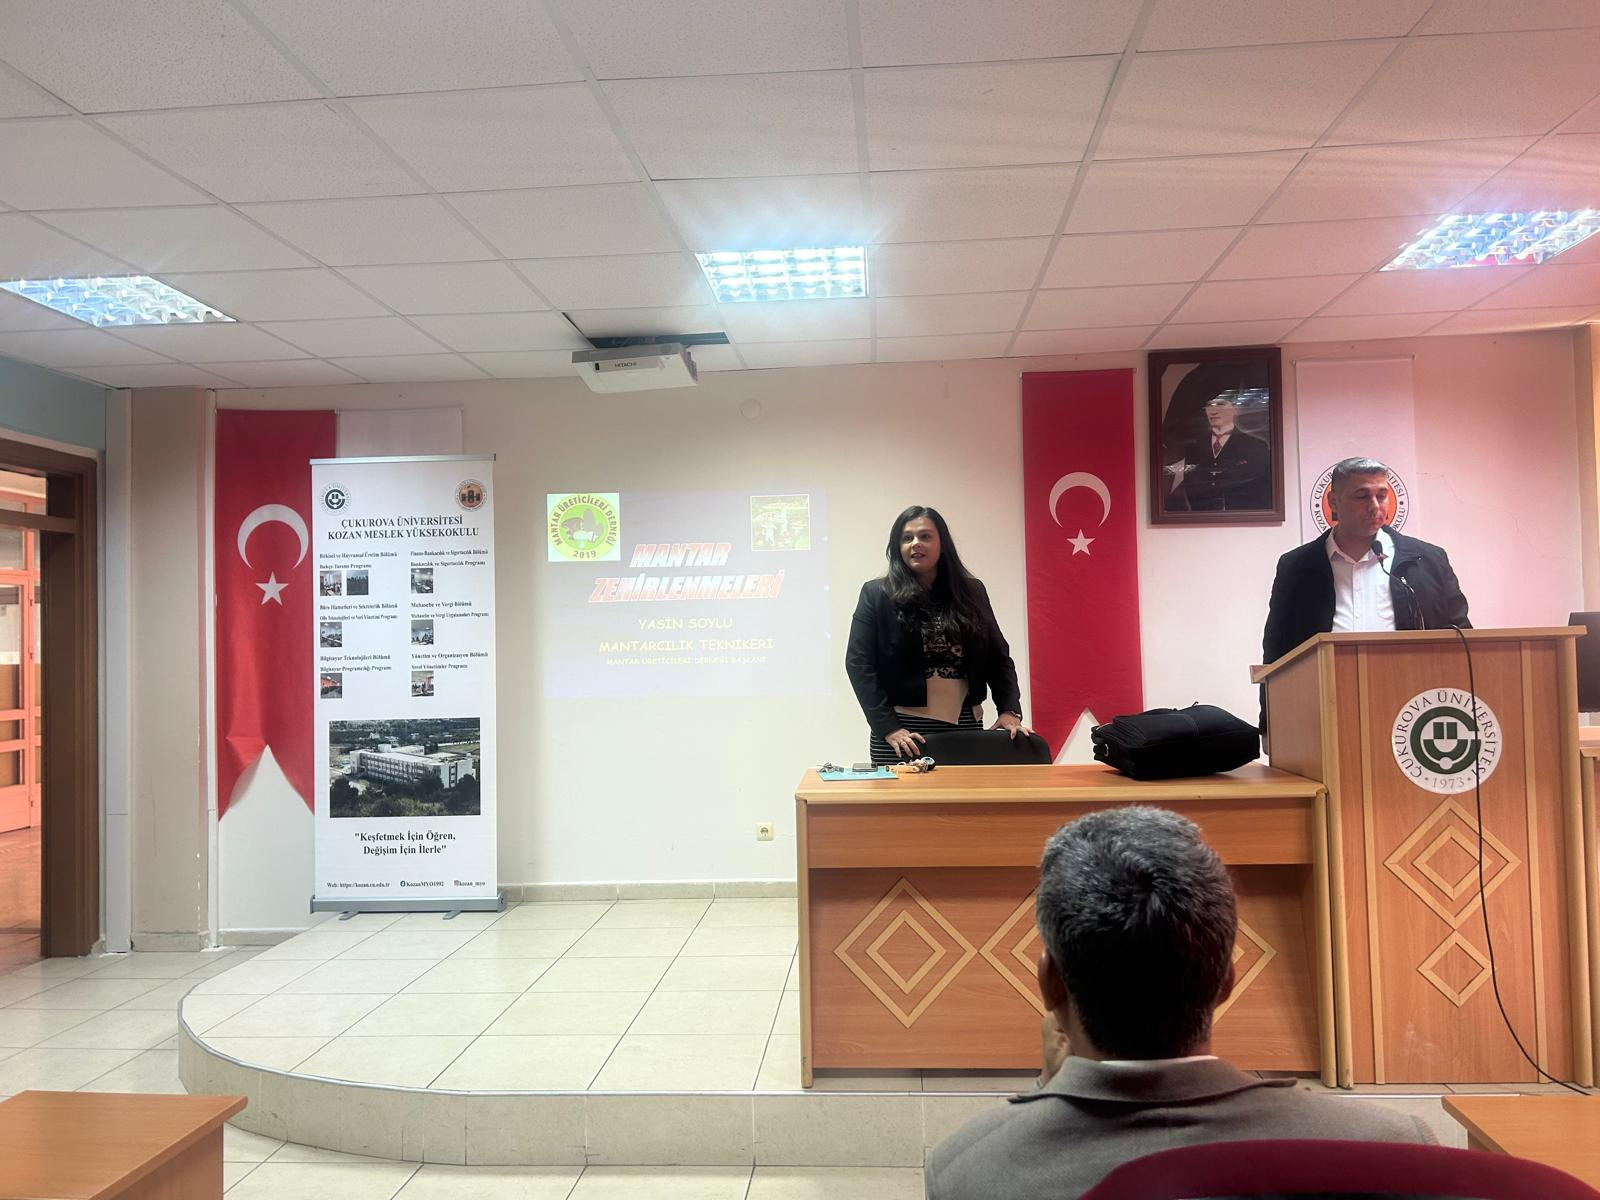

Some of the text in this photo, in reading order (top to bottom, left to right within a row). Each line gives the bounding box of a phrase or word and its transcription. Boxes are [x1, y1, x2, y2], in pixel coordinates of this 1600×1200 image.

[1314, 471, 1333, 500] ÇUKUR
[341, 515, 463, 529] ÇUKUROVA ÜNİVERSİTESİ
[551, 495, 617, 546] MANTAR ÜRETİCİLERİ DERNEĞİ
[1314, 510, 1327, 531] KOZA
[328, 527, 479, 540] KOZAN MESLEK YÜKSEKOKULU
[573, 550, 597, 559] 2019
[629, 542, 732, 568] MANTAR
[638, 616, 733, 630] YASİN SOYLU
[599, 638, 775, 652] MANTARCILIK TEKNİKERİ
[1395, 696, 1432, 778] ÇUKUROVA
[1432, 777, 1465, 789] 1973
[354, 829, 456, 843] "Keşfetmek İçin Öğren,
[363, 843, 447, 856] Değişim İçin İlerle"
